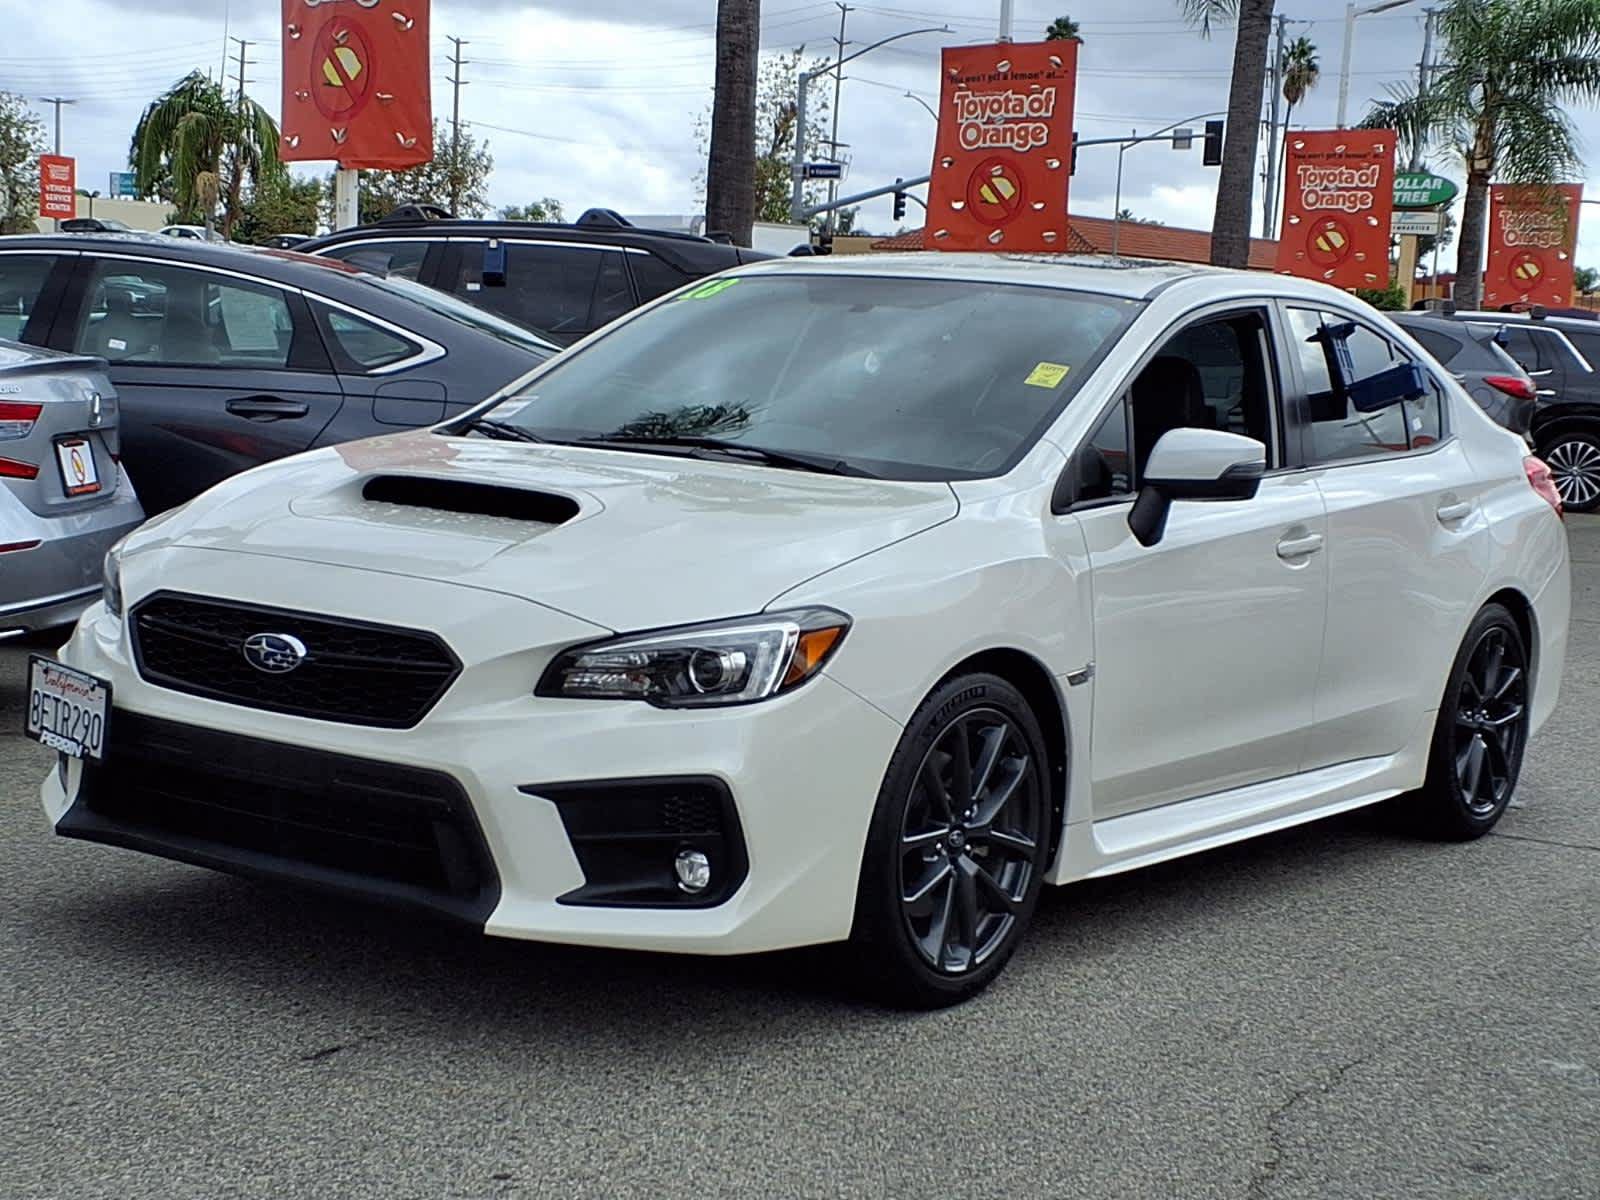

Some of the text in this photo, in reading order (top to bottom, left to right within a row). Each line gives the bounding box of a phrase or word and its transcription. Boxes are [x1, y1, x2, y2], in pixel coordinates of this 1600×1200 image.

[953, 87, 1056, 123] Toyota of
[960, 120, 1049, 151] Orange
[1297, 164, 1380, 189] Toyota of
[1393, 177, 1442, 190] OLLAR
[45, 193, 72, 203] SERVICE
[1302, 188, 1374, 213] Orange
[1393, 191, 1430, 203] TREE
[46, 203, 71, 212] CENTER
